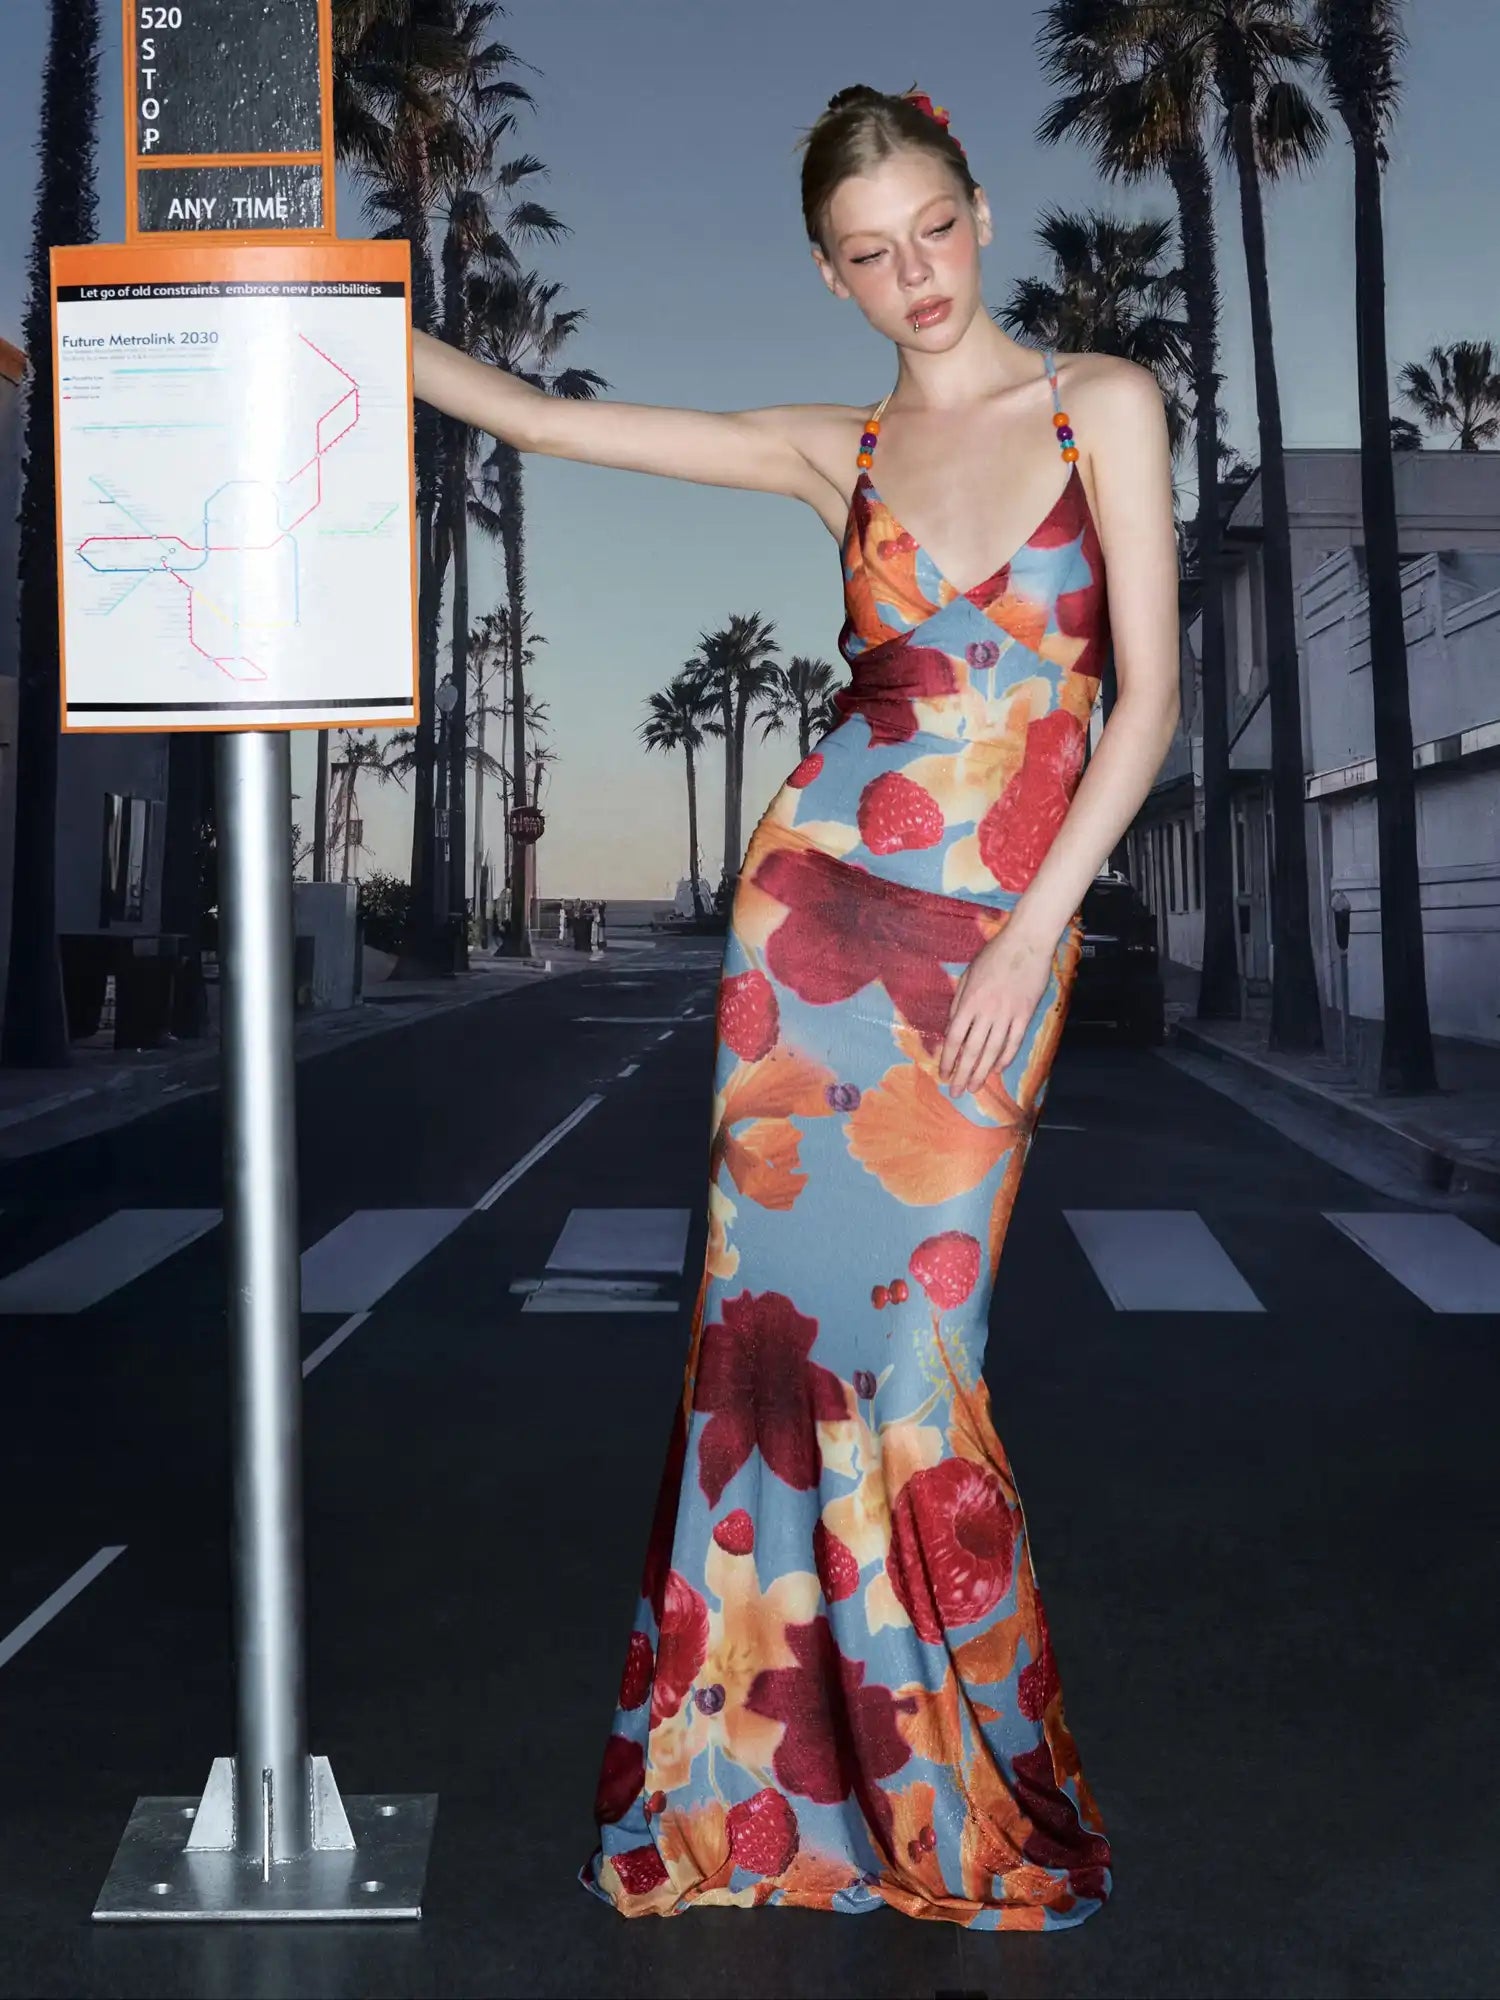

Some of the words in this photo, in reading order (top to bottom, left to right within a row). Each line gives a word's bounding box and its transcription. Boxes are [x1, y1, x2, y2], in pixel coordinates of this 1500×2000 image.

[140, 7, 182, 29] 520
[141, 38, 161, 150] STOP
[168, 198, 217, 219] ANY
[232, 197, 288, 219] TIME
[80, 287, 98, 298] Let
[101, 289, 115, 300] go
[118, 286, 130, 297] of
[132, 285, 150, 296] old
[153, 284, 220, 296] constraints
[225, 283, 279, 295] embrace
[282, 285, 309, 295] new
[311, 283, 381, 296] possibilities
[62, 335, 105, 347] Future
[109, 333, 175, 346] Metrolink
[180, 331, 219, 344] 2030
